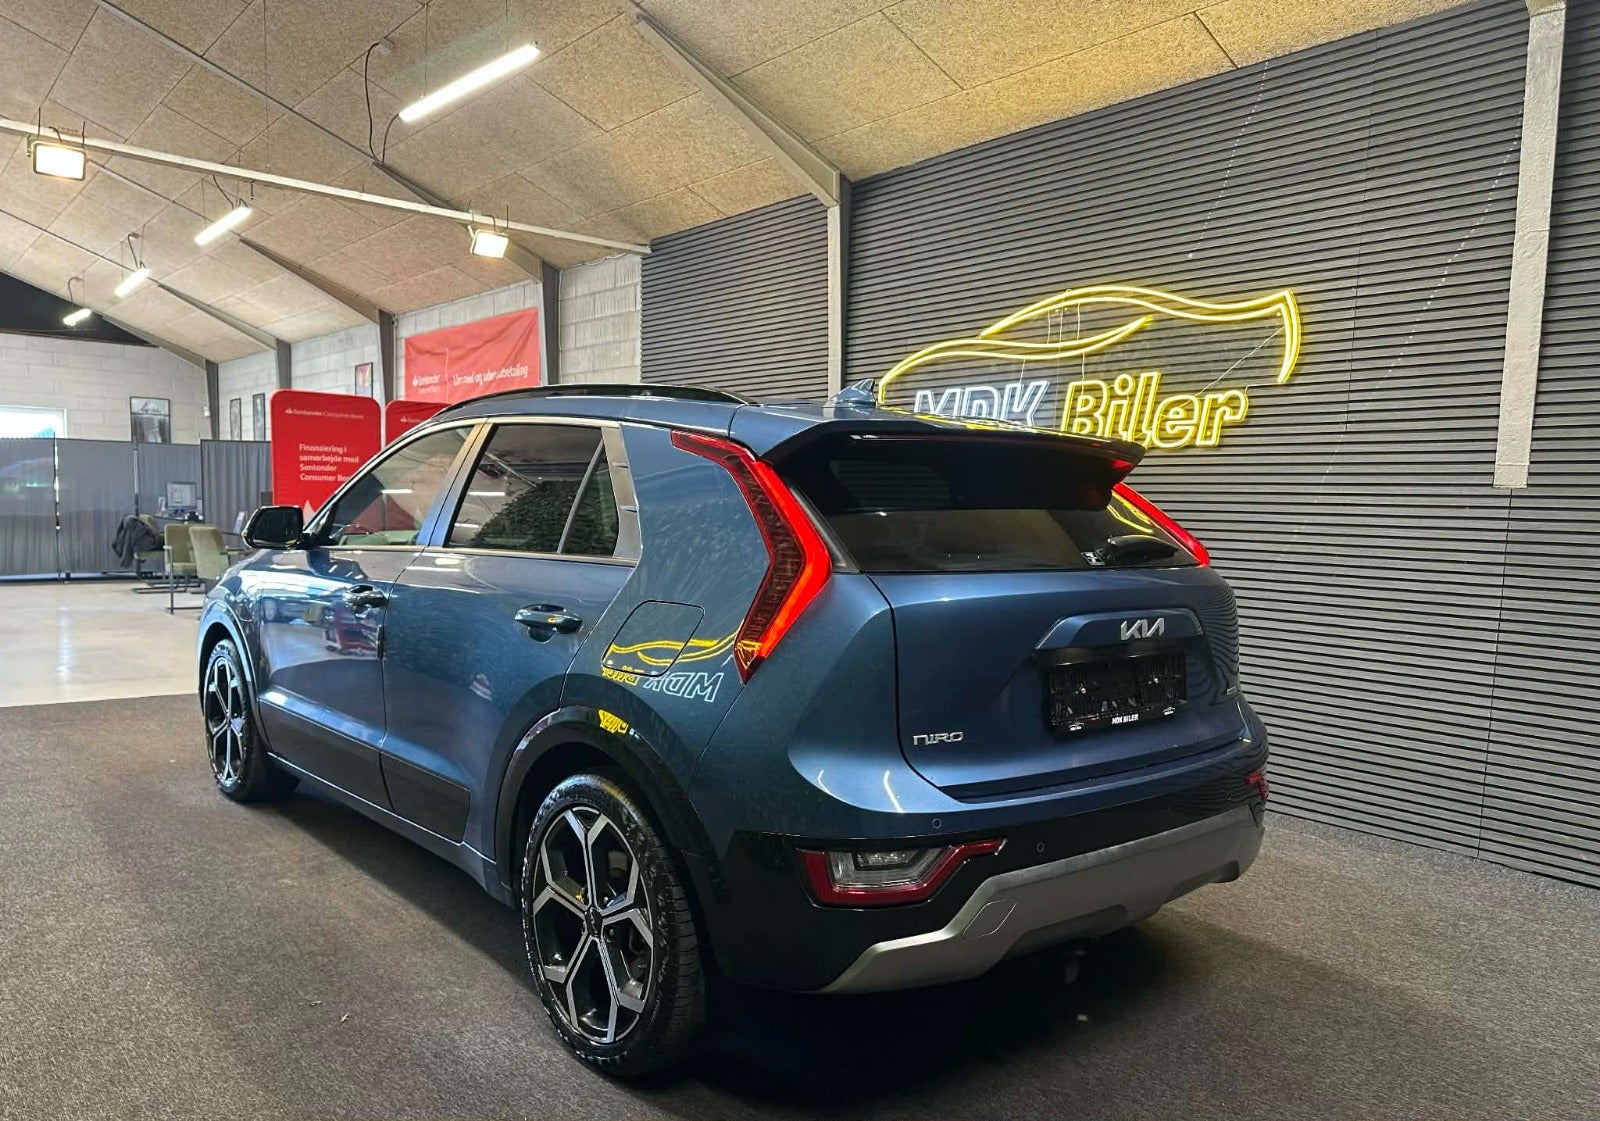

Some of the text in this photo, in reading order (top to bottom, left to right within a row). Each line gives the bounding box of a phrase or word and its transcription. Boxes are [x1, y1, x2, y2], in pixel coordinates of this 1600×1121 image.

[1060, 371, 1250, 450] Biler
[299, 443, 343, 454] Finansiering
[299, 454, 342, 463] samarbejde
[299, 463, 337, 472] Santander
[299, 473, 336, 482] Consumer
[1120, 617, 1165, 641] KIA
